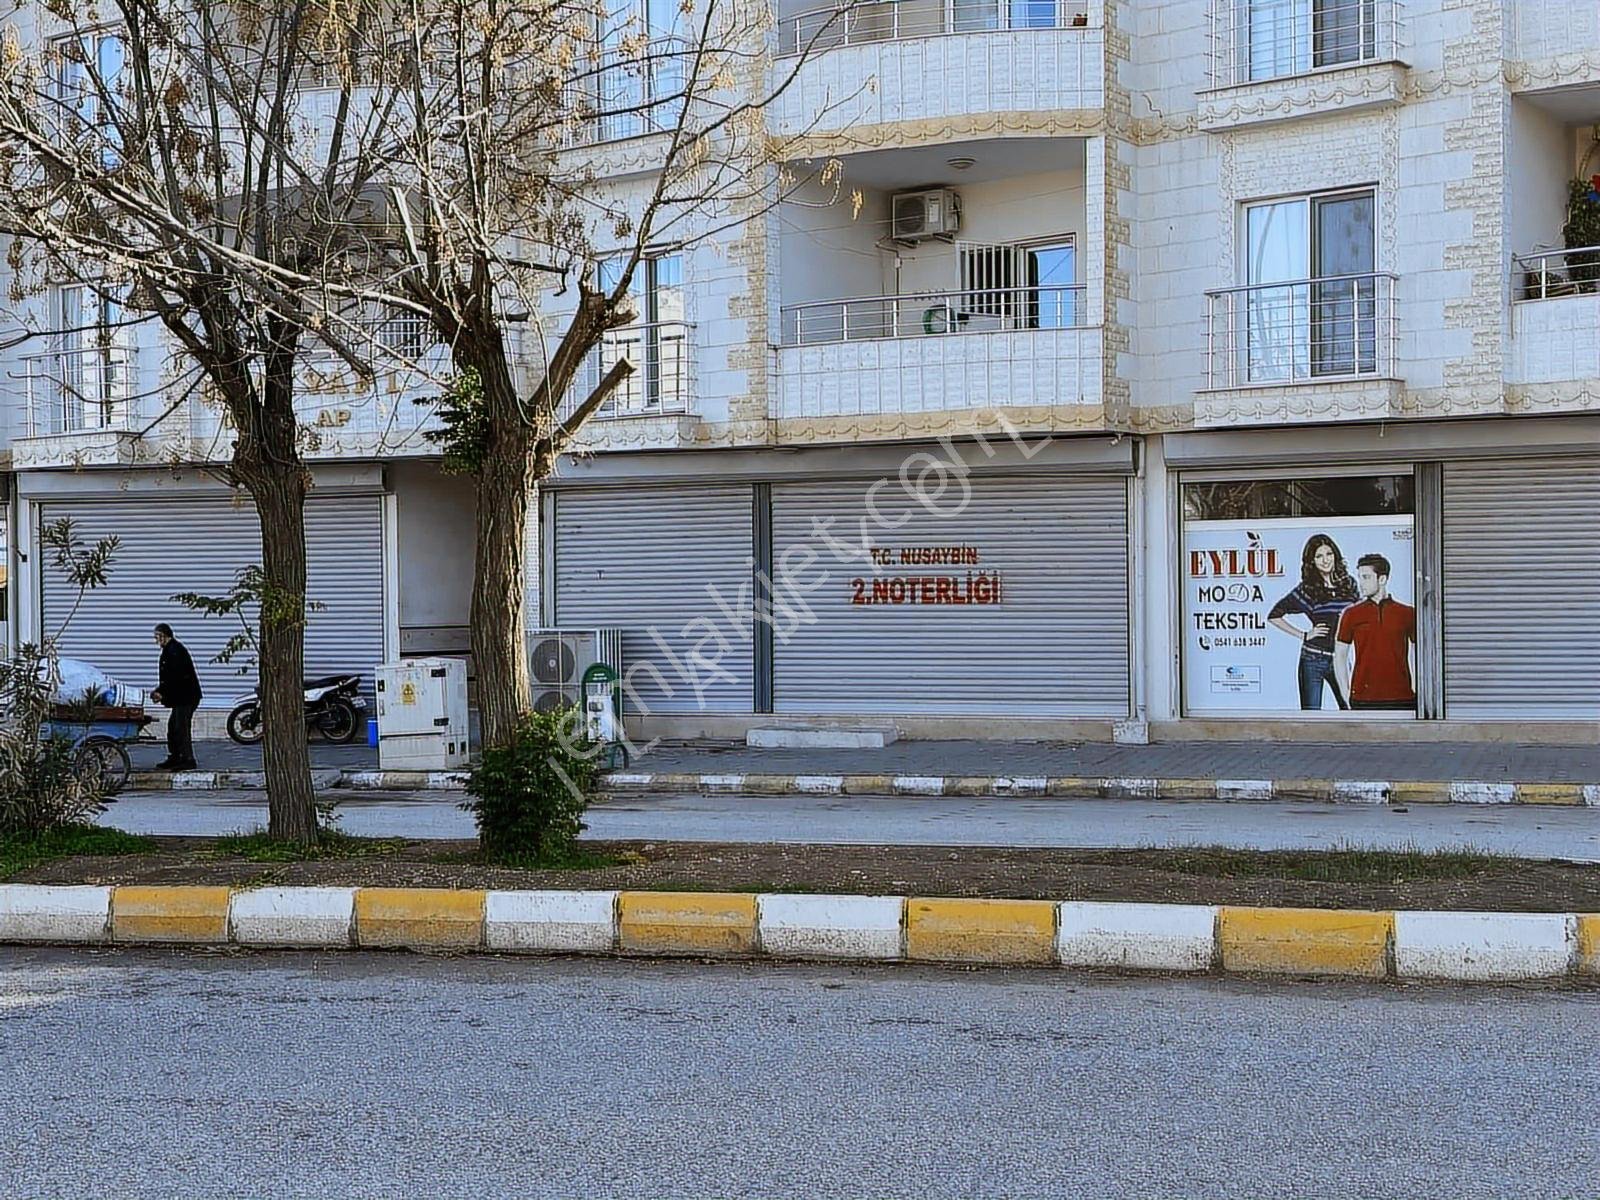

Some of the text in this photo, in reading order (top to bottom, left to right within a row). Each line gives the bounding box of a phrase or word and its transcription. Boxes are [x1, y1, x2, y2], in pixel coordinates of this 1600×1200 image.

[870, 543, 978, 565] T.C. NUSAYBİN
[1190, 538, 1285, 578] EYLÜL
[852, 570, 999, 604] 2.NOTERLİĞİ
[1198, 583, 1264, 603] MODA
